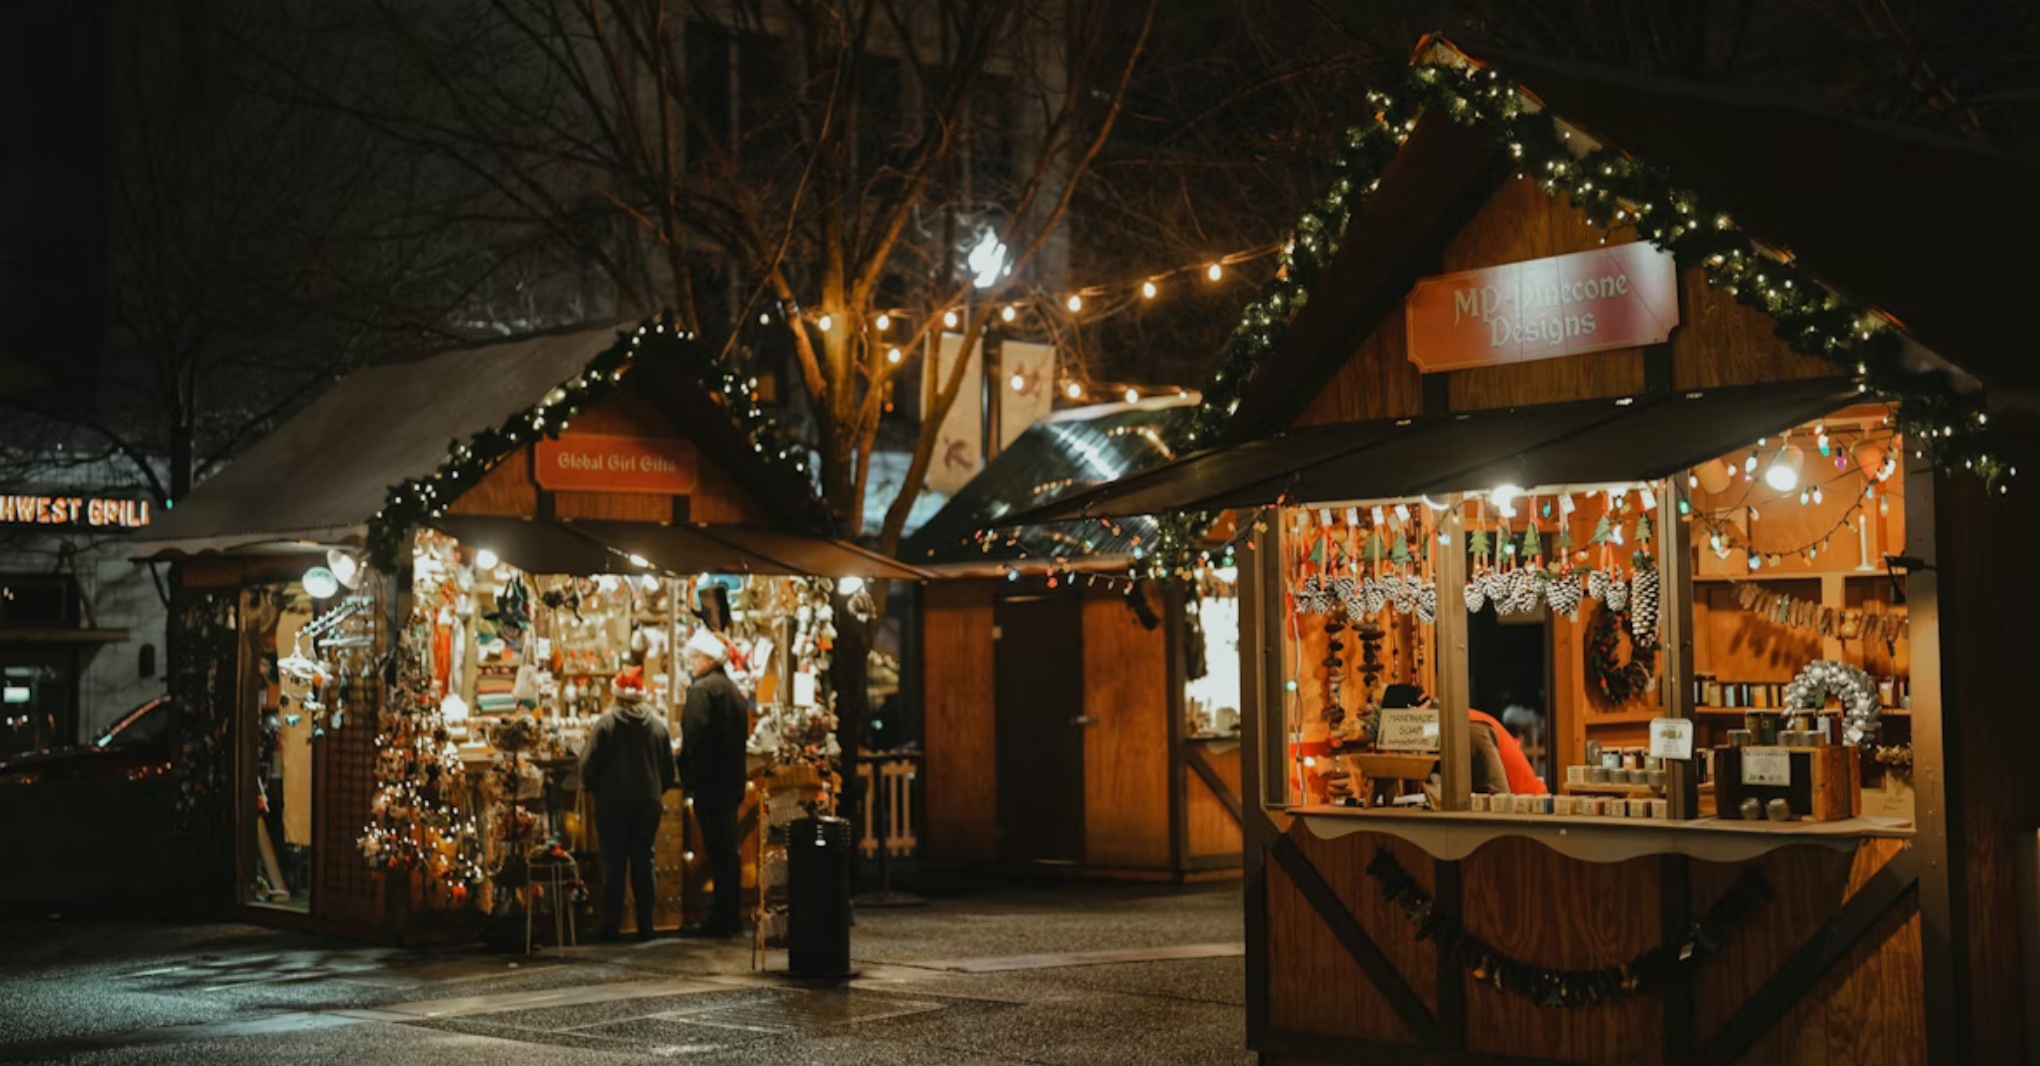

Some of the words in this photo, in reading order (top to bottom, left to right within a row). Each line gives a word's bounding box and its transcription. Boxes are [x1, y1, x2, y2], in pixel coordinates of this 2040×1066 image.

[1453, 285, 1500, 325] MP
[1514, 274, 1629, 319] Pinecone
[1490, 312, 1597, 347] Designs
[557, 452, 603, 470] Global
[607, 454, 636, 472] Girl
[640, 456, 677, 473] Gifts
